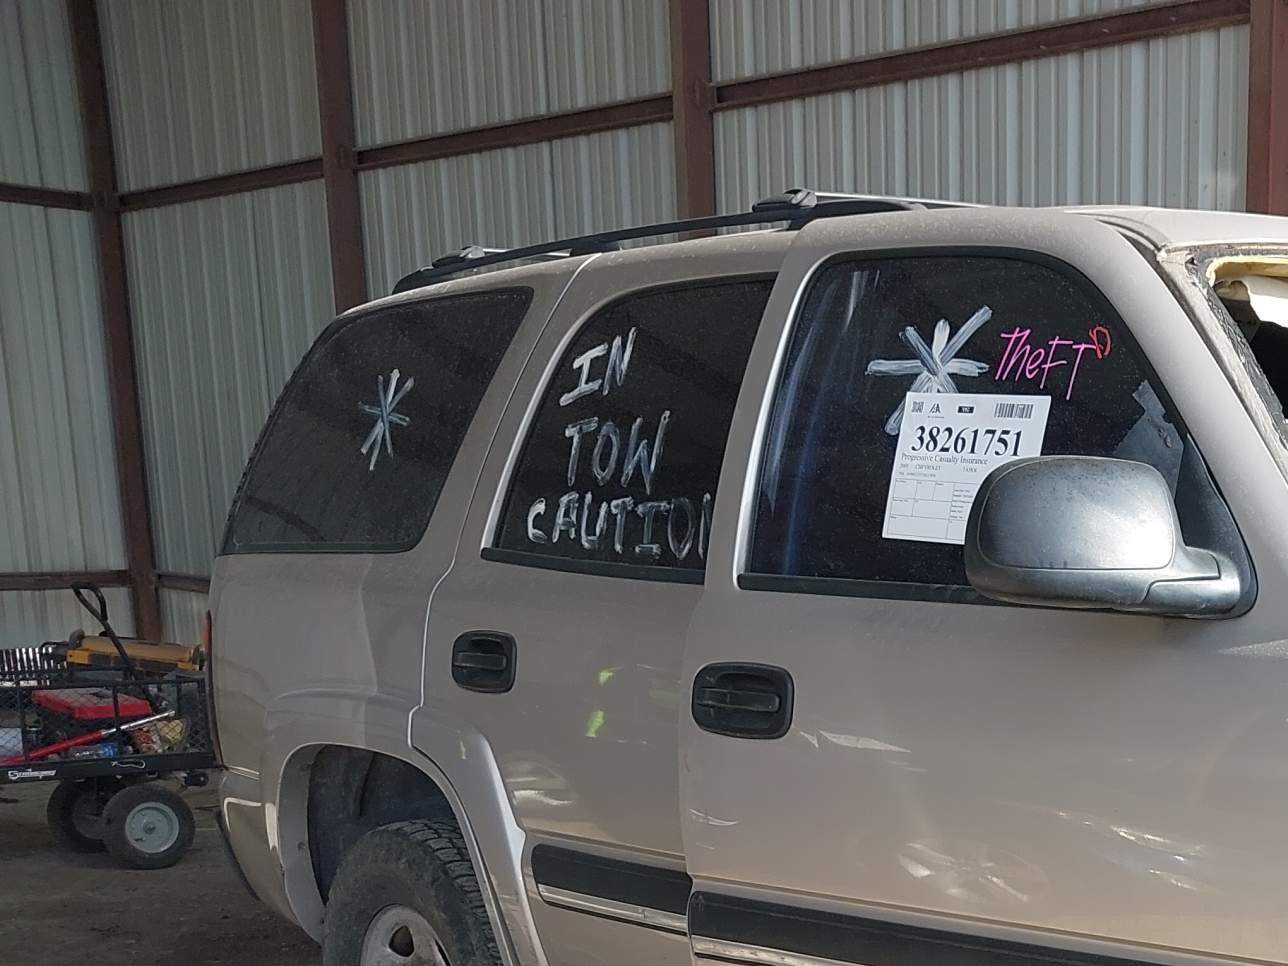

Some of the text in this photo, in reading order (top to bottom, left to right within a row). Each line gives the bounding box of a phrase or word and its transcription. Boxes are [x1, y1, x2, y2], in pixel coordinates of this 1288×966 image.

[559, 327, 637, 406] IN
[564, 410, 671, 495] TOW
[911, 425, 1022, 457] 38261751
[934, 455, 959, 464] Casualty
[960, 456, 988, 465] Insurance
